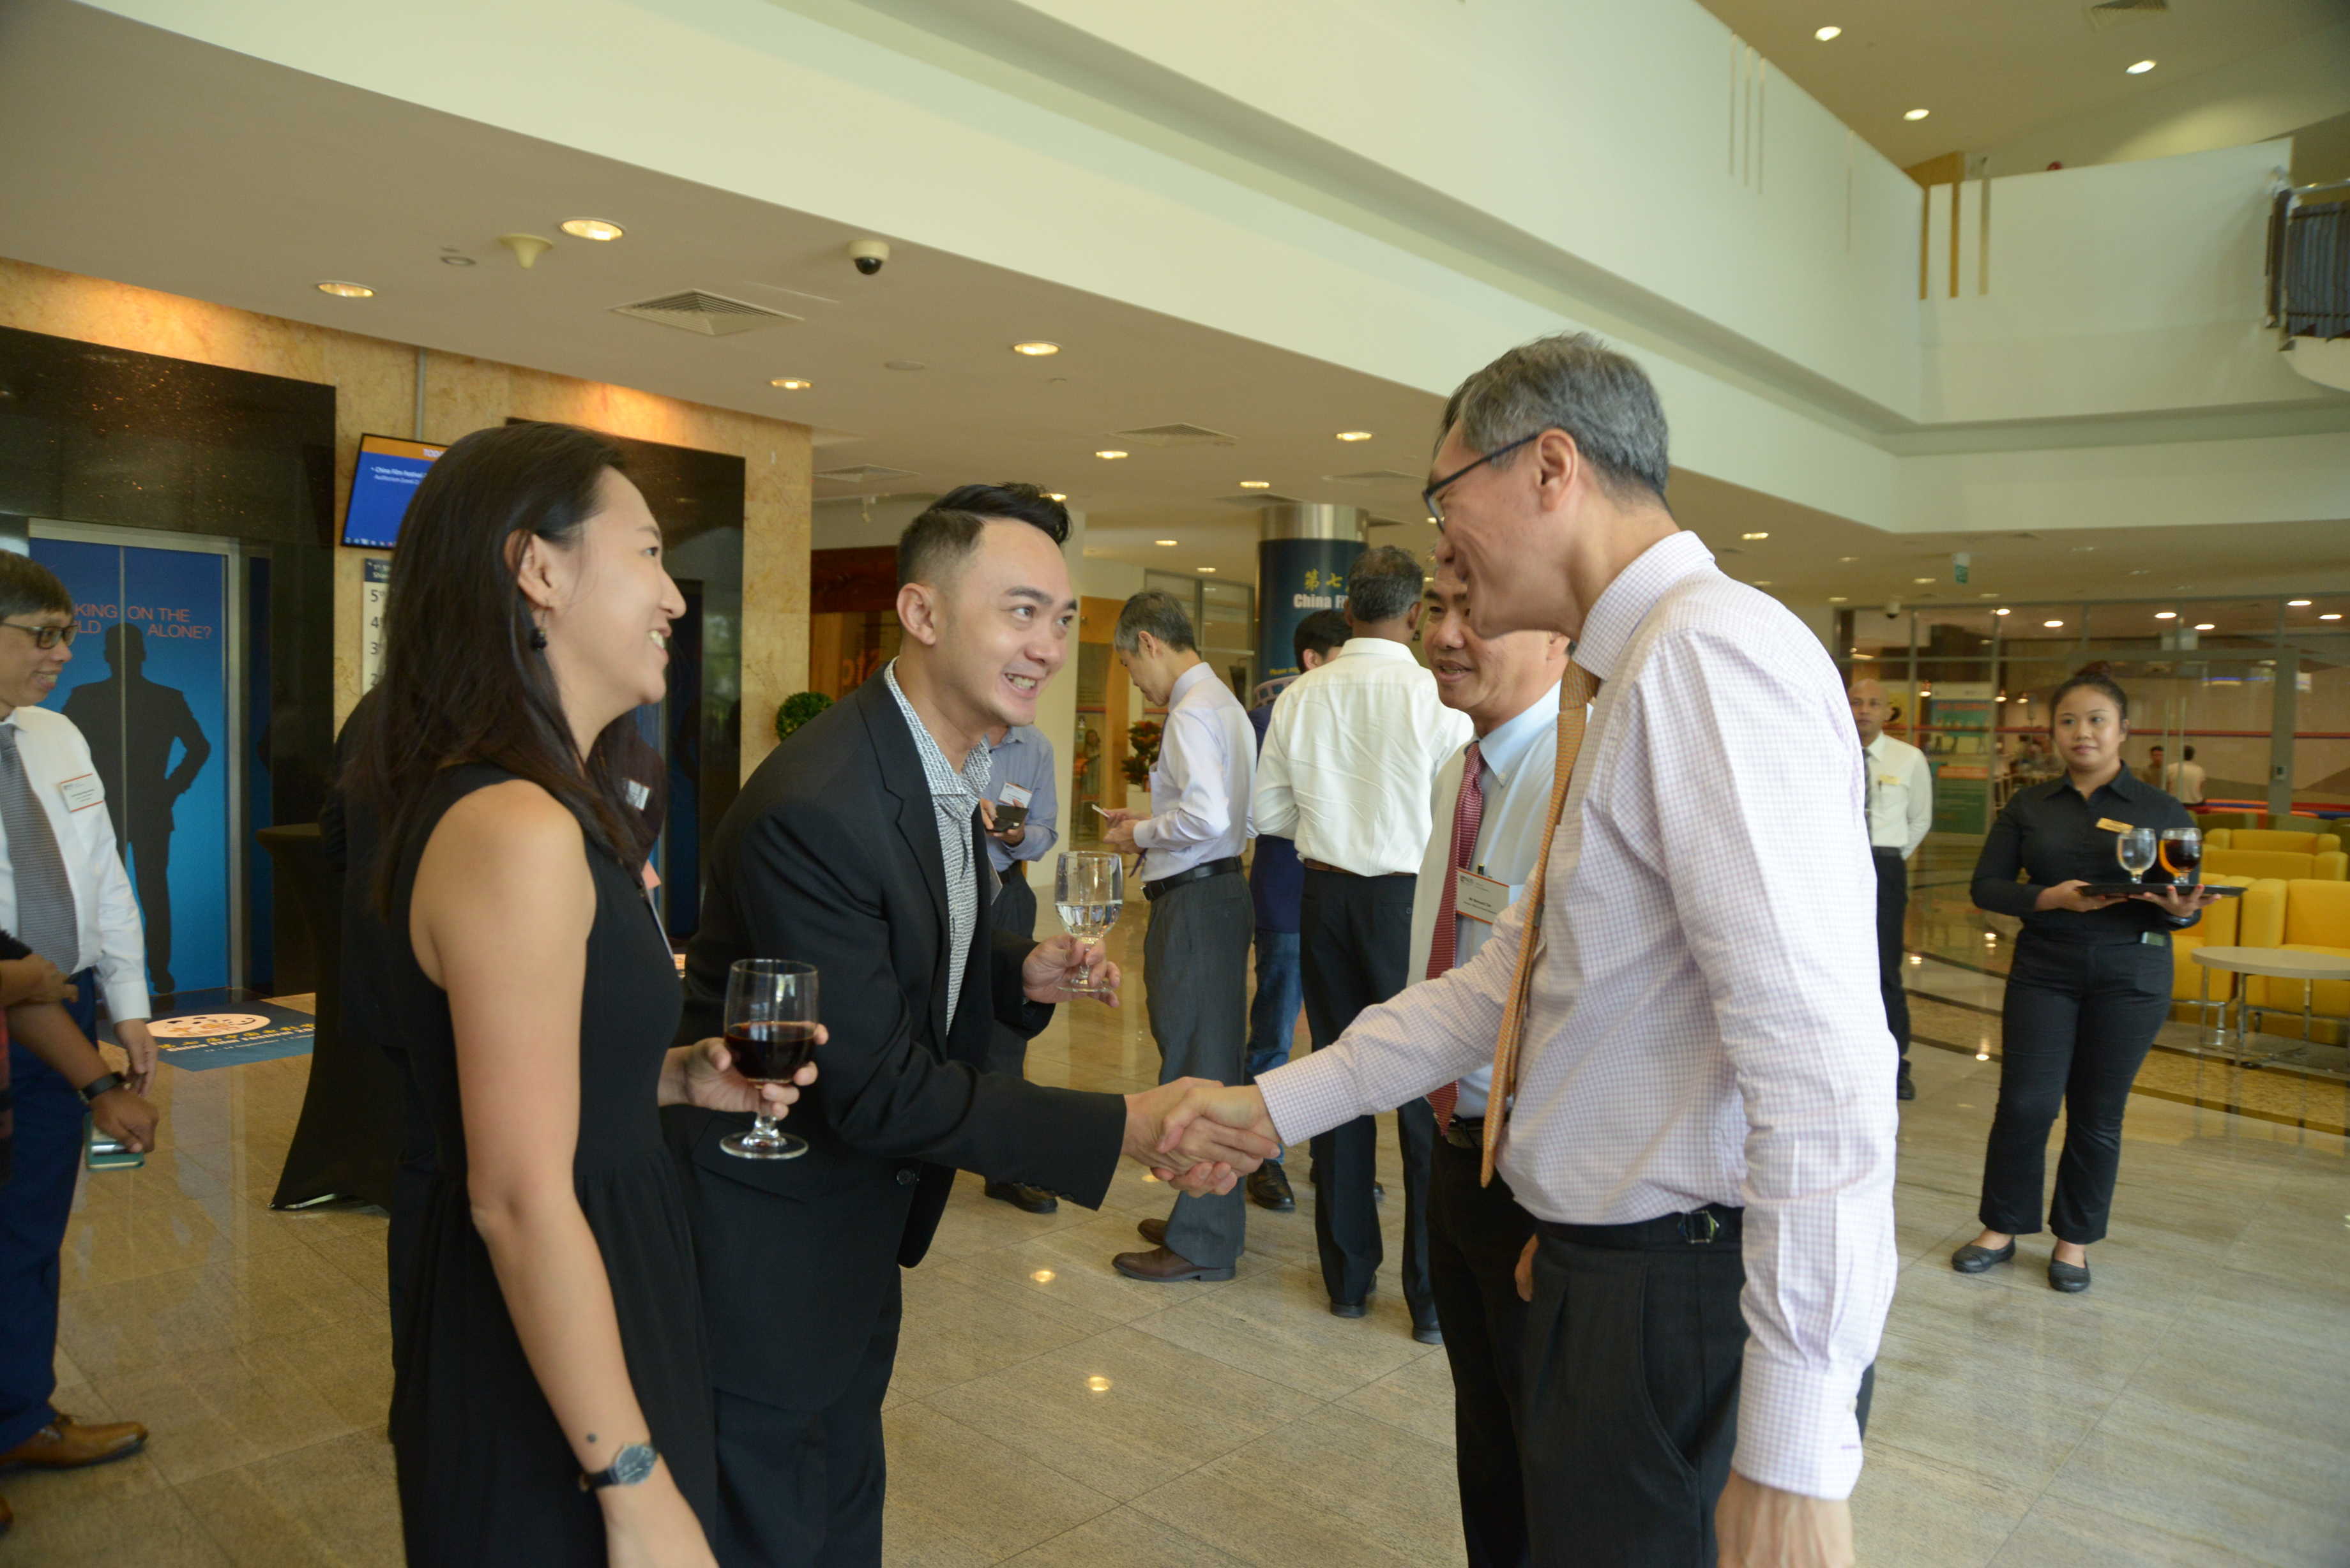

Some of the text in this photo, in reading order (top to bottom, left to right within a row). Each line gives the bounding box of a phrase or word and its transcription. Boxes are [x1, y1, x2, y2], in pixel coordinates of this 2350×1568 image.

[1304, 568, 1349, 592] 第七
[1293, 594, 1332, 608] China
[74, 603, 190, 622] KING ON THE
[74, 619, 213, 639] LD ALONE?
